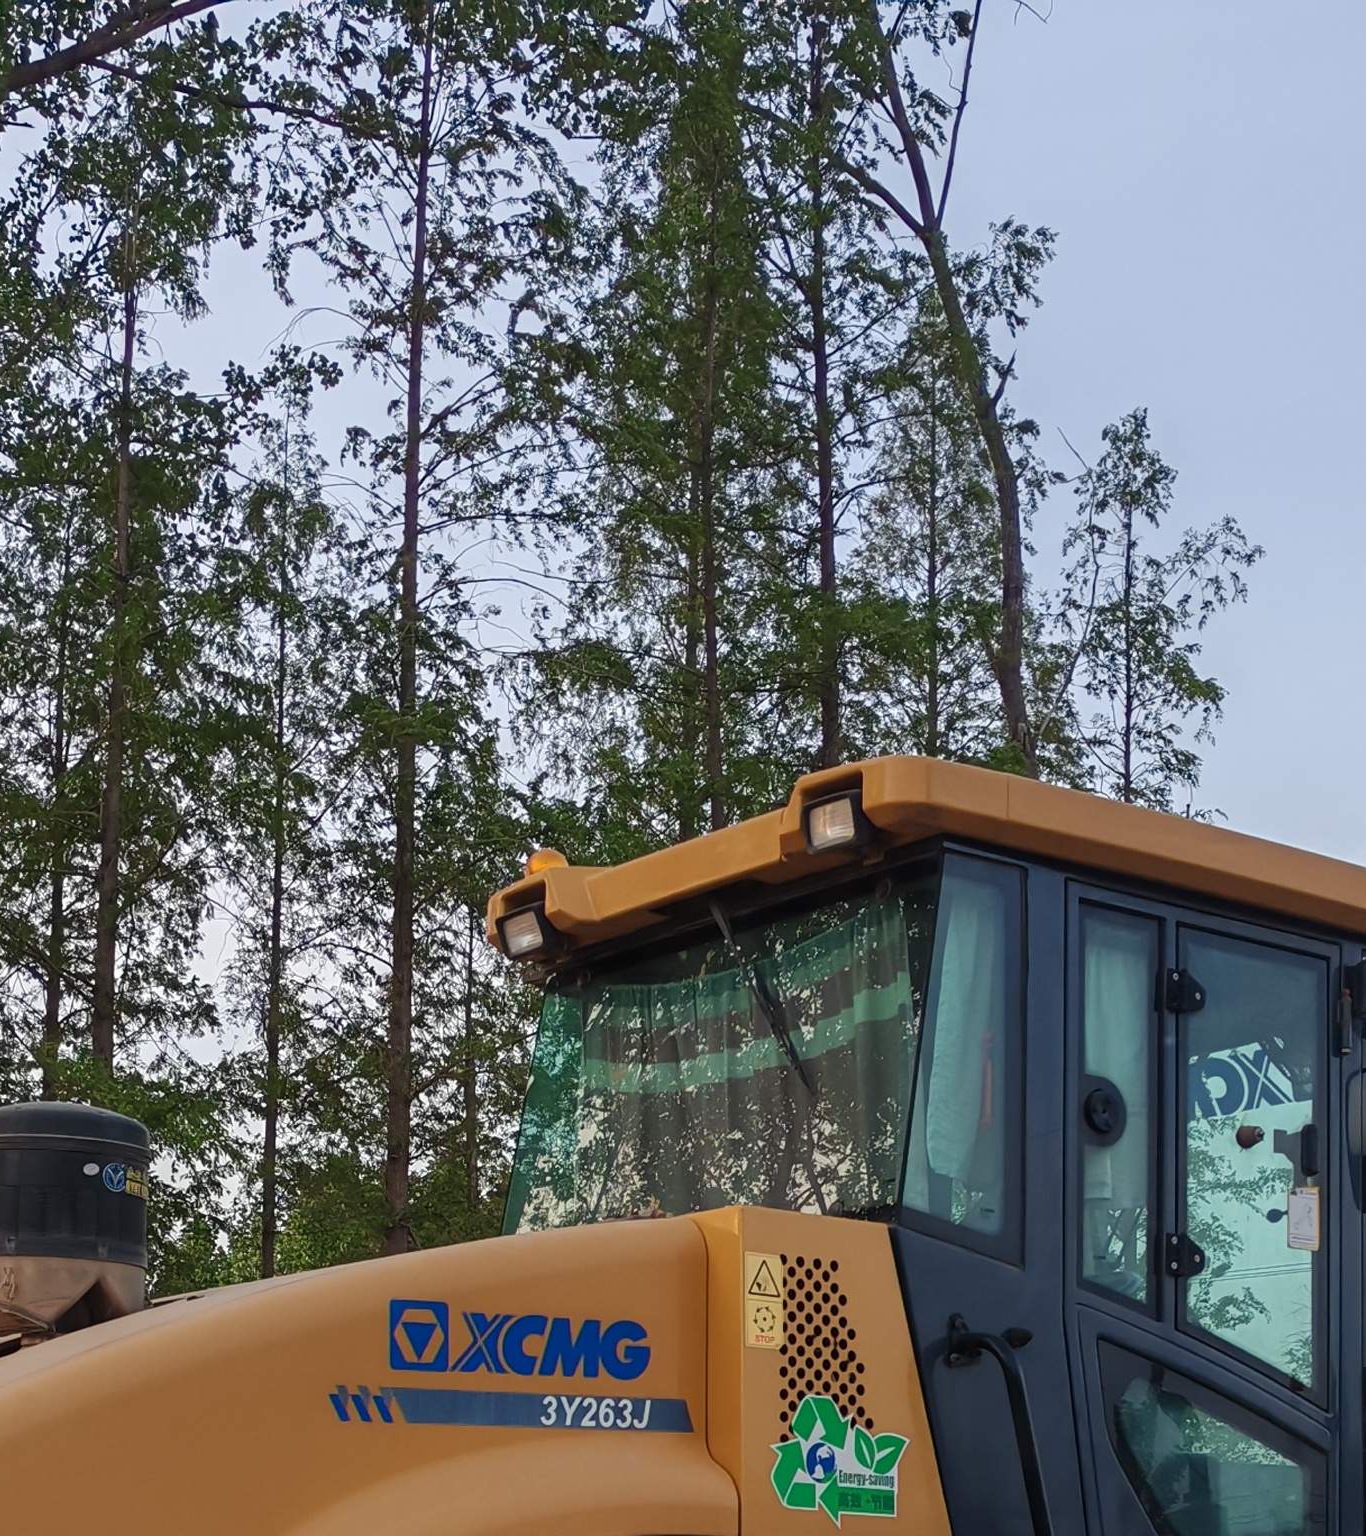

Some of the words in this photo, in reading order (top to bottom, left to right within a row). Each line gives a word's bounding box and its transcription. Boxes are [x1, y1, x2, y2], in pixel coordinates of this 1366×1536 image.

[449, 1312, 651, 1381] XCMG
[755, 1334, 776, 1344] STOP
[540, 1396, 651, 1430] 3Y263J
[838, 1470, 895, 1489] Energy-saving
